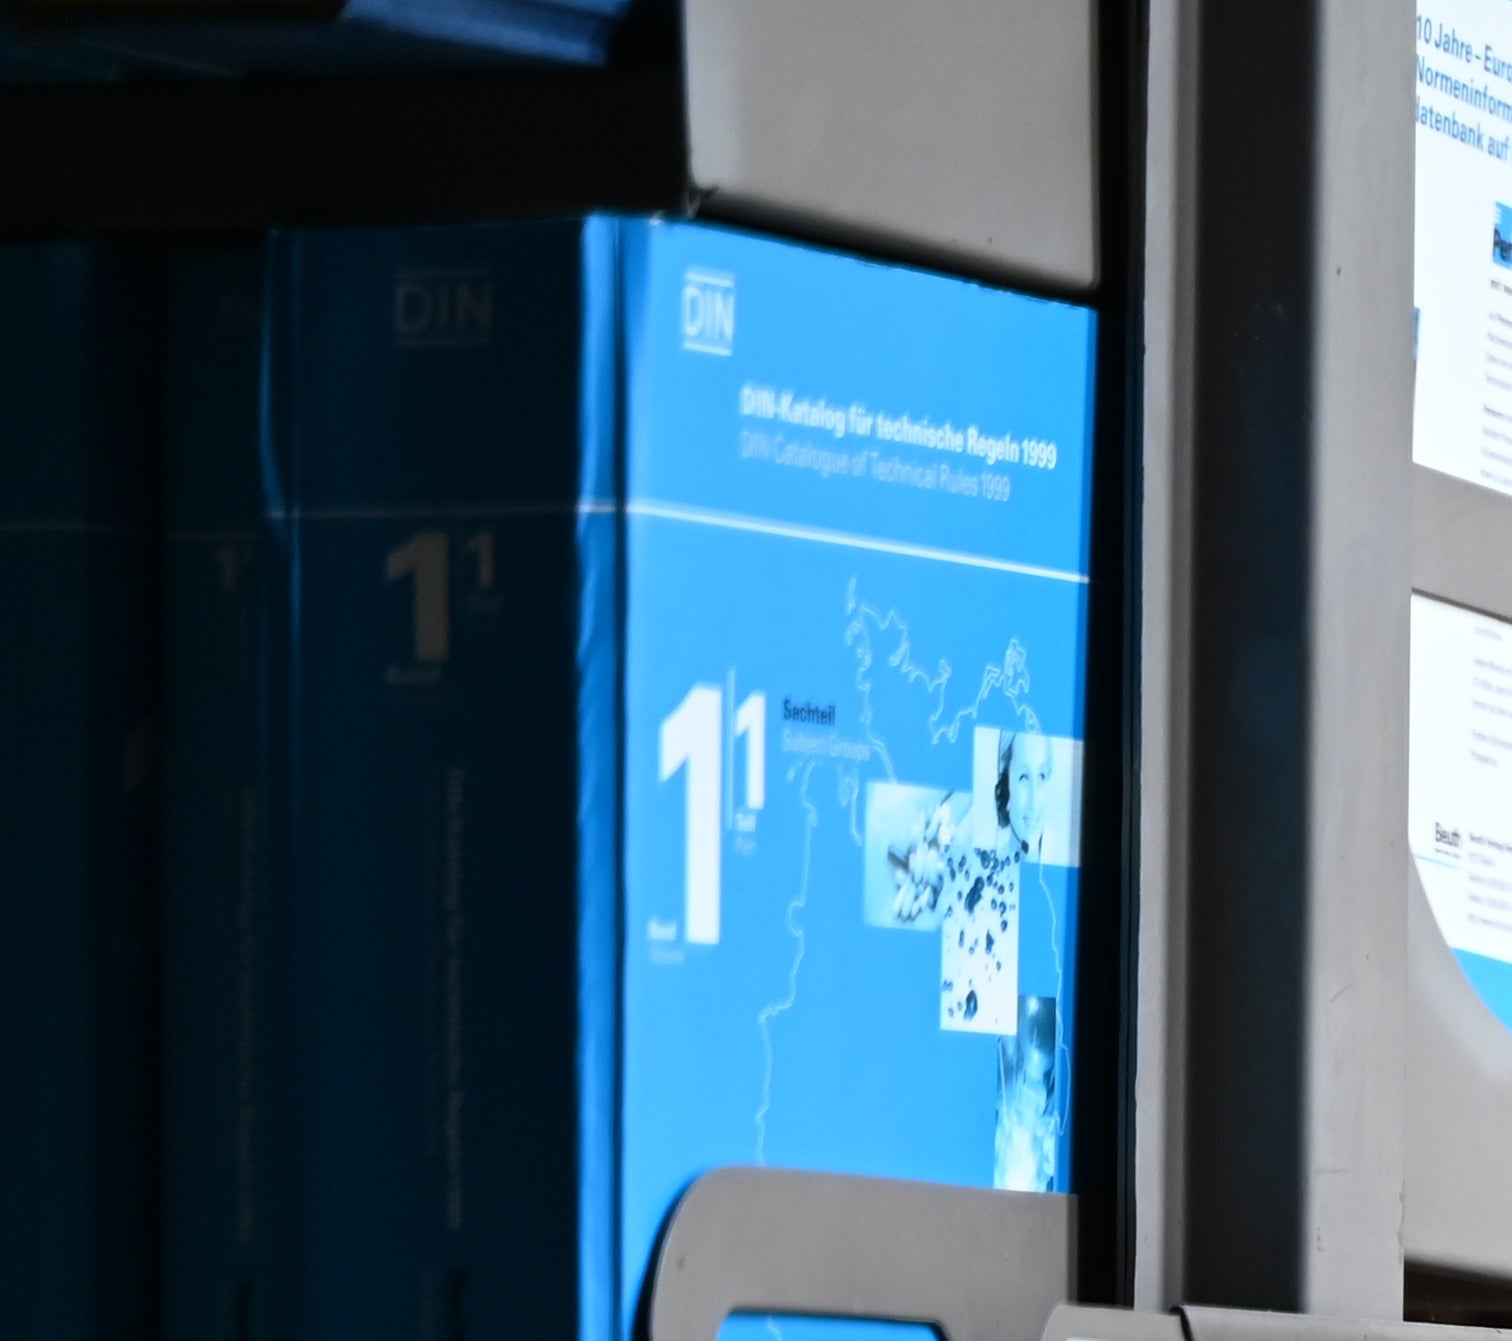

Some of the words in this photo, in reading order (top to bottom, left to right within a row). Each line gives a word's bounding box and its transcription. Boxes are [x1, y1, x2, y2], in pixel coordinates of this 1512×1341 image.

[1434, 23, 1473, 64] Jahre
[1488, 135, 1510, 161] auf
[395, 280, 495, 336] DIN
[682, 286, 736, 342] DIN
[740, 384, 846, 438] DIN-Katalog
[848, 404, 874, 436] für
[876, 413, 964, 453] technische
[966, 427, 1020, 465] Regeln
[1022, 438, 1058, 470] 1999
[775, 437, 851, 478] Catalogue
[869, 452, 938, 490] Technical
[940, 464, 980, 497] Rules
[981, 472, 1011, 502] 1999
[783, 699, 836, 726] Sachteil
[659, 683, 721, 945] 1
[735, 692, 765, 809] 1
